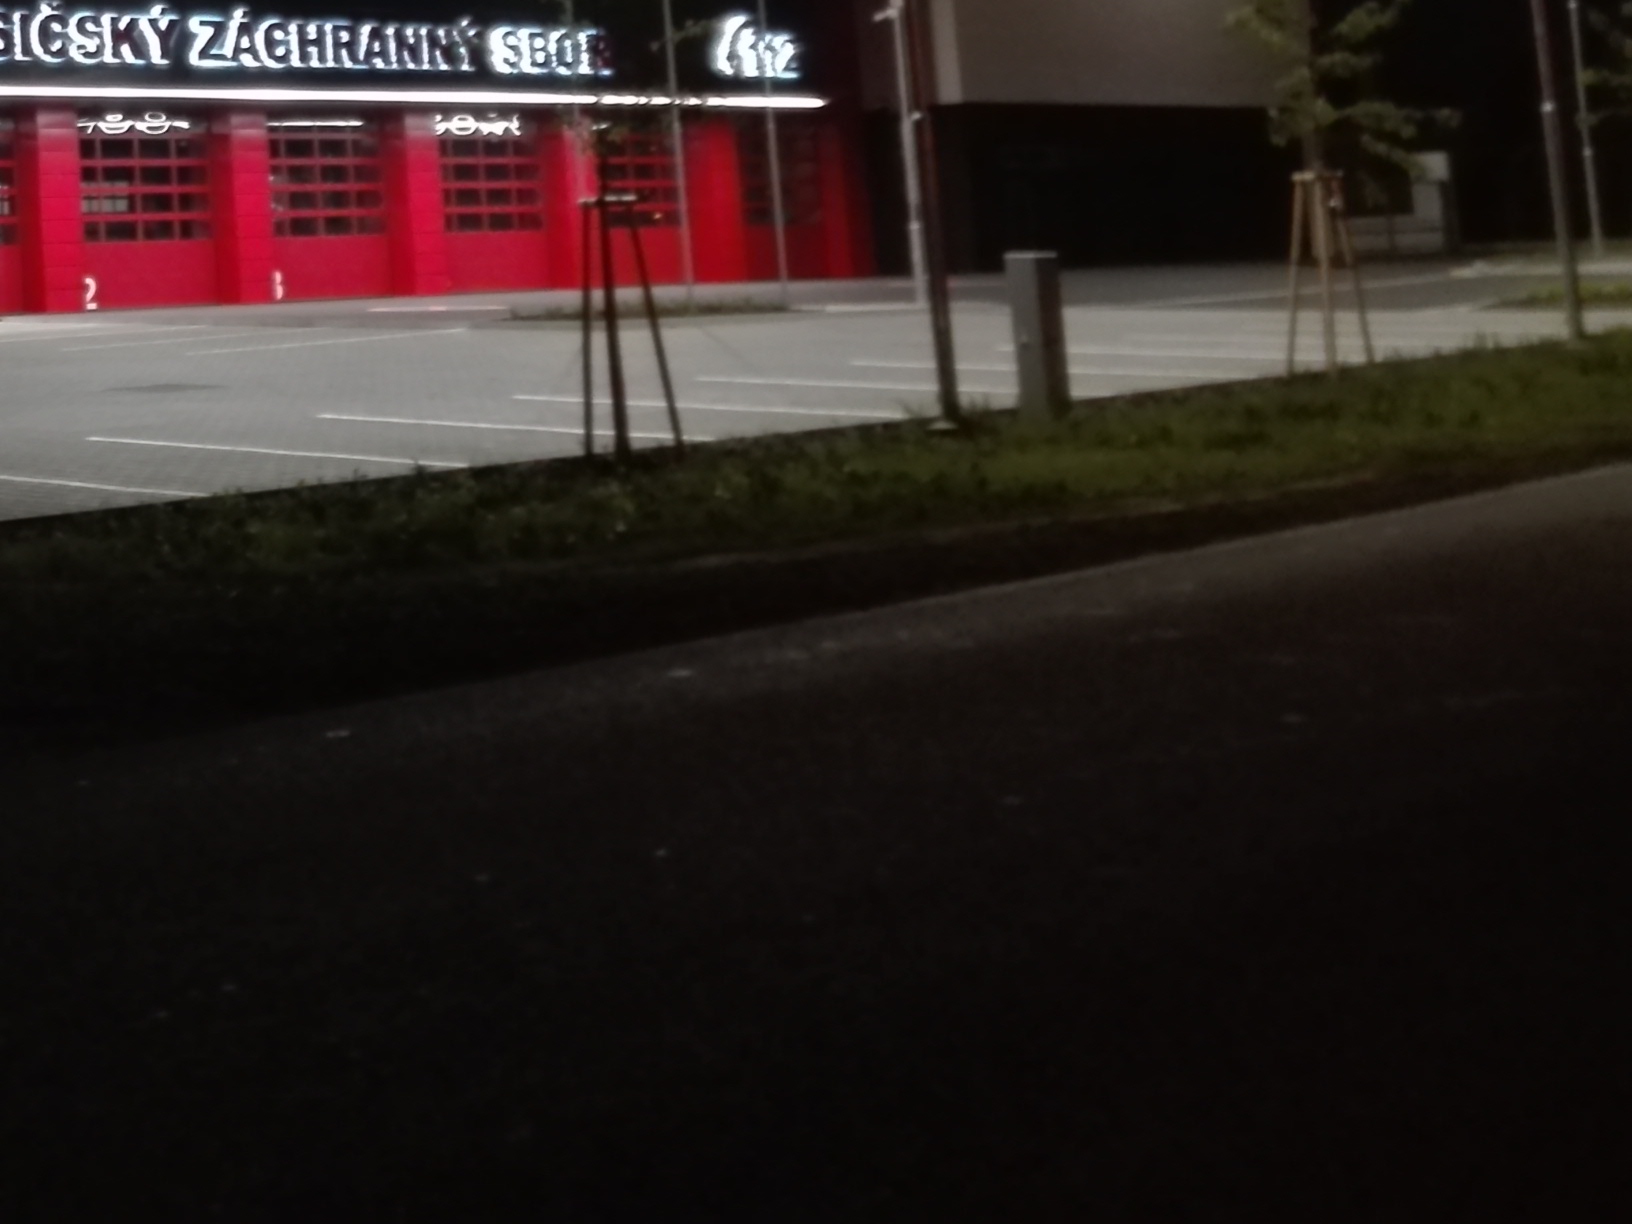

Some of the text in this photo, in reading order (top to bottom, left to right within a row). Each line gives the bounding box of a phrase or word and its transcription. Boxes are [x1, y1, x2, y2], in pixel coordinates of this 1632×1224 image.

[186, 7, 477, 71] ZÁCHRANNÝ
[488, 25, 614, 76] SBOR
[84, 277, 98, 311] 2
[273, 270, 284, 302] 3
